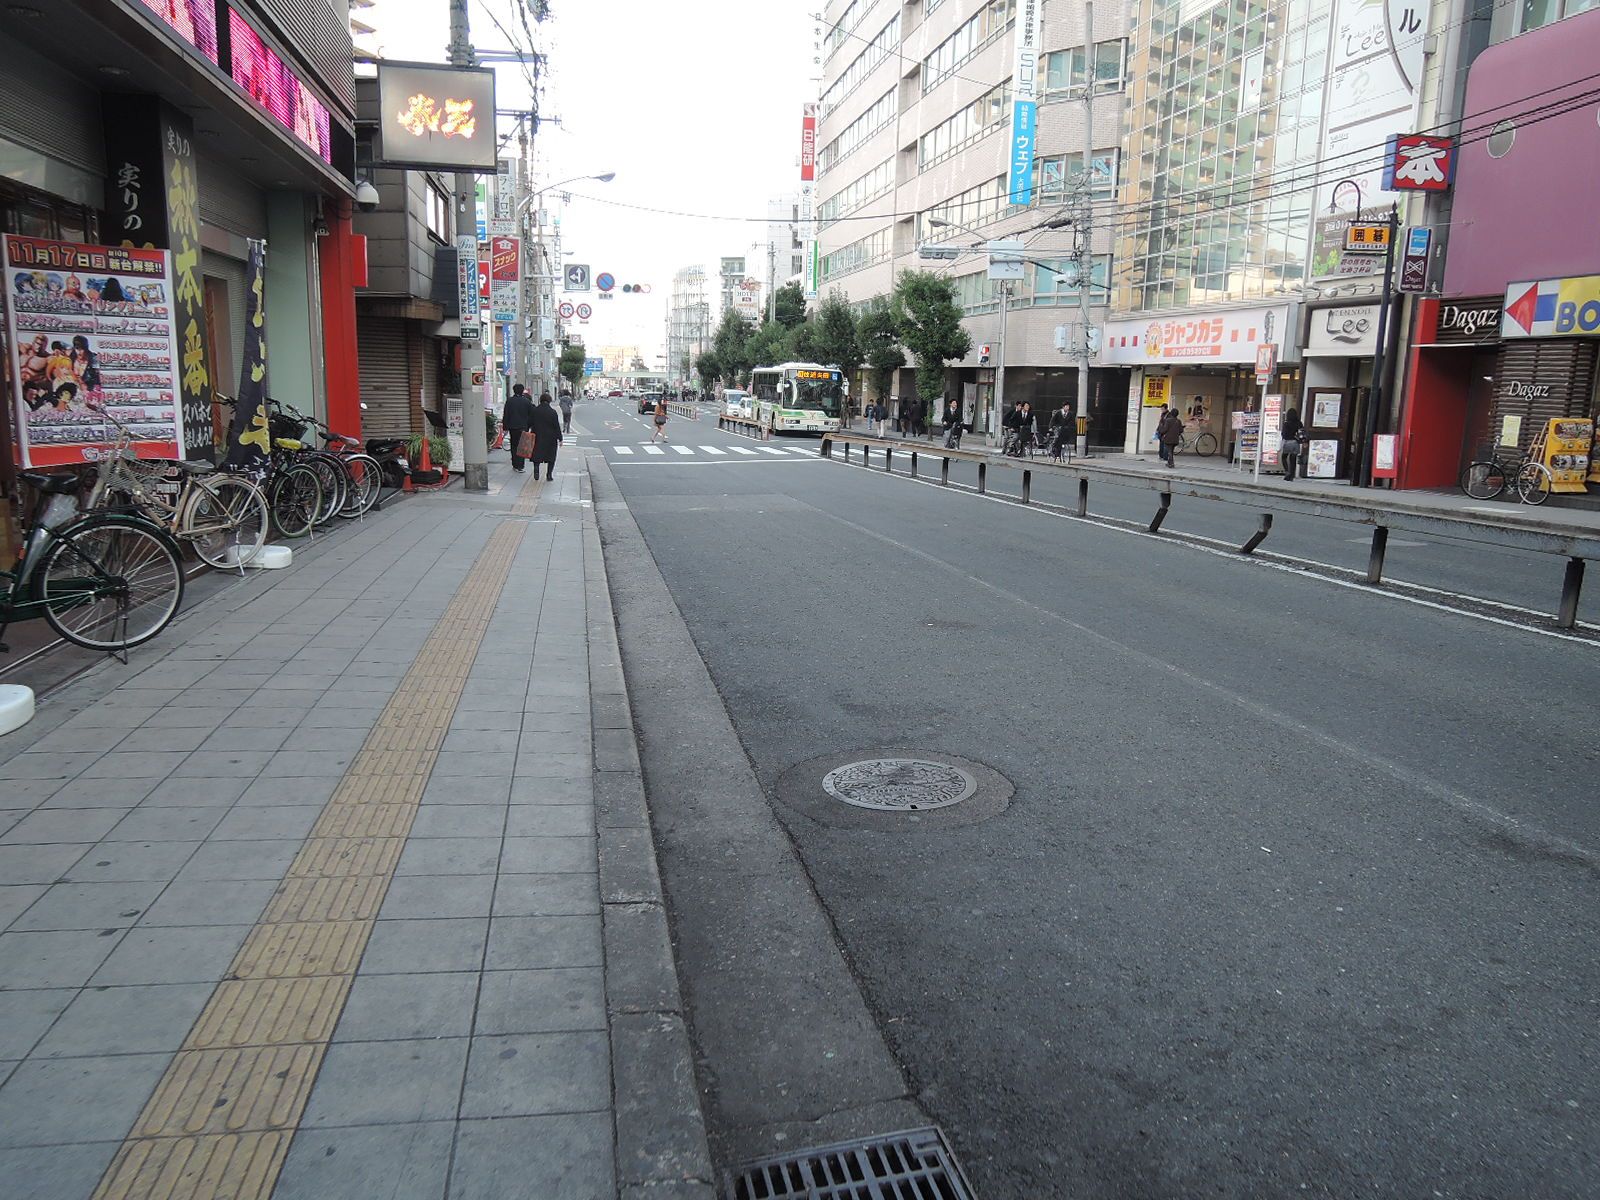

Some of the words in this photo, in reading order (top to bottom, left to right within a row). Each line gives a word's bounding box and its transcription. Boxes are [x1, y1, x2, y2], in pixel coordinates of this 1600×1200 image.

[167, 125, 190, 157] 実りの
[803, 129, 814, 166] 日能研
[1396, 141, 1446, 185] 本
[118, 163, 142, 230] 実りの
[1354, 229, 1384, 242] 囲碁
[109, 259, 162, 274] 新台解禁!!
[495, 252, 515, 268] スナック
[169, 159, 206, 397] 秋本番
[1164, 318, 1224, 345] ジャンカラ
[1326, 310, 1370, 335] Lee
[1443, 306, 1499, 335] Dagaz
[1509, 381, 1550, 401] Dagaz
